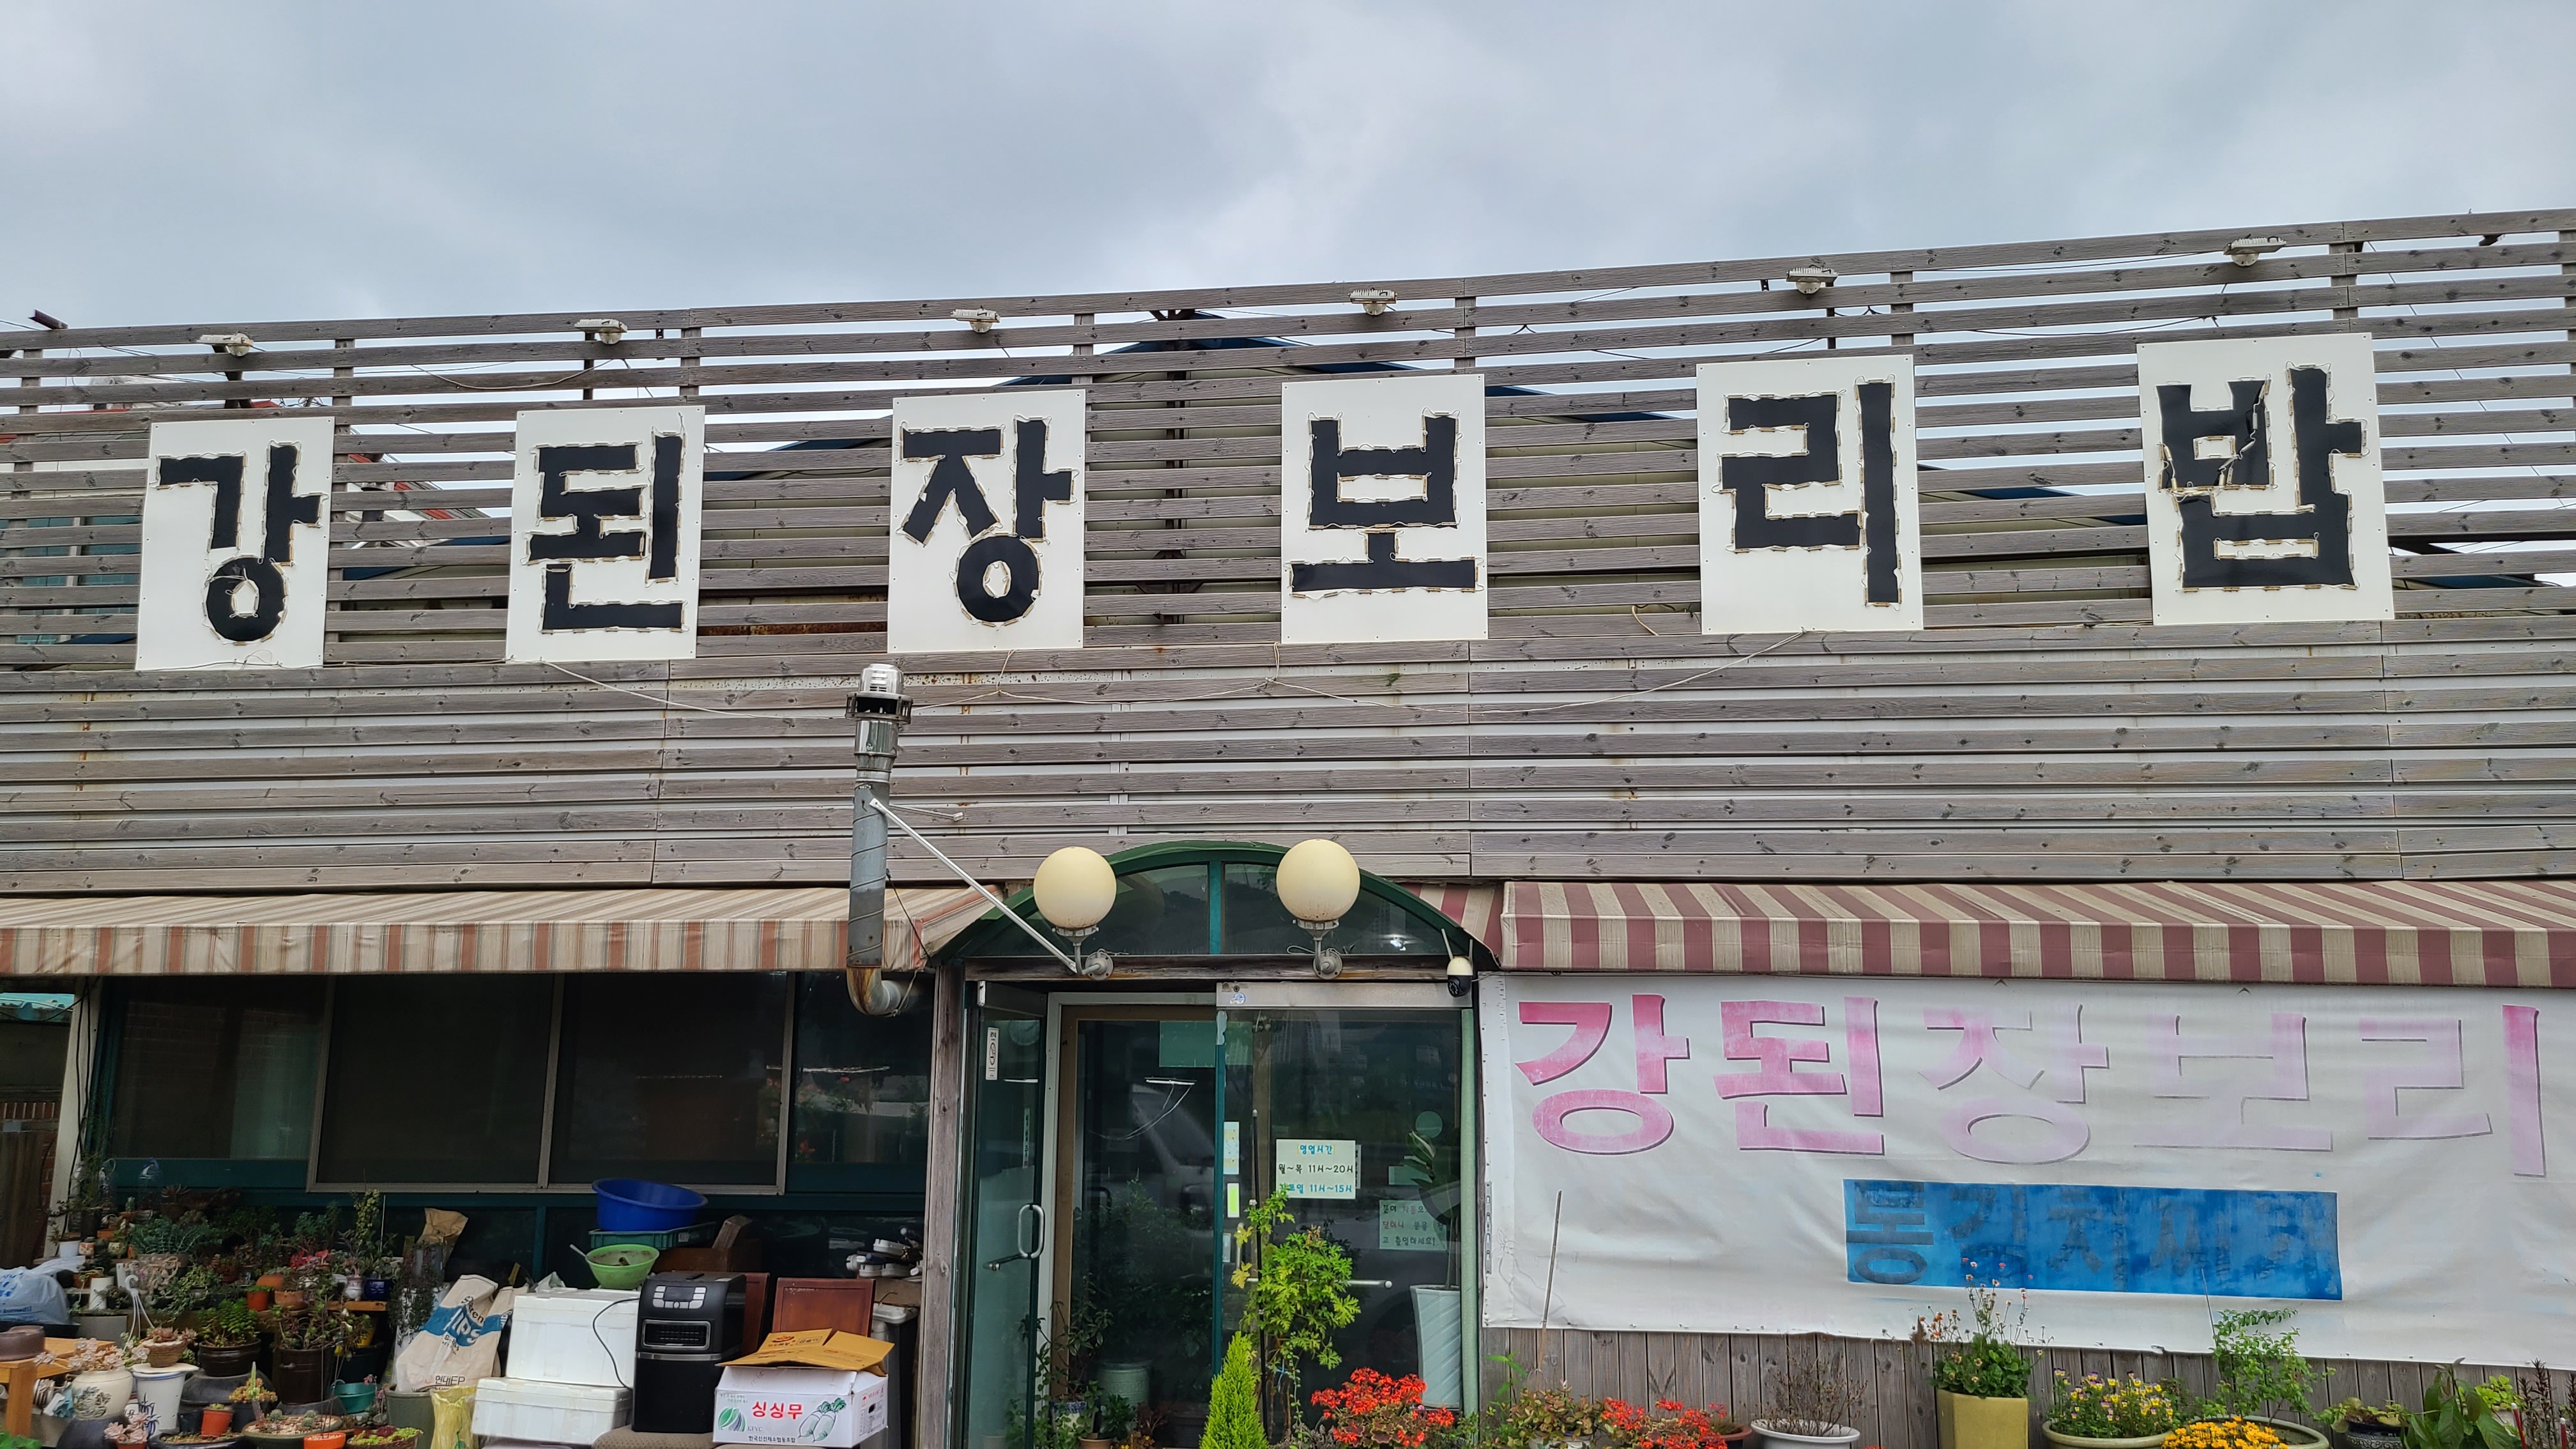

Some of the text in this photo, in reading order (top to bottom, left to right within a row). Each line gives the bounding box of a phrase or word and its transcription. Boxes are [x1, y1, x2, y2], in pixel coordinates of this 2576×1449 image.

[1517, 993, 2547, 1177] 강된장보리
[1278, 1163, 1353, 1174] 월~목 11시~20시
[1279, 1183, 1352, 1194] 토일 11시~15시
[1402, 1206, 1428, 1215] 자동으
[752, 1400, 803, 1420] 싱싱무
